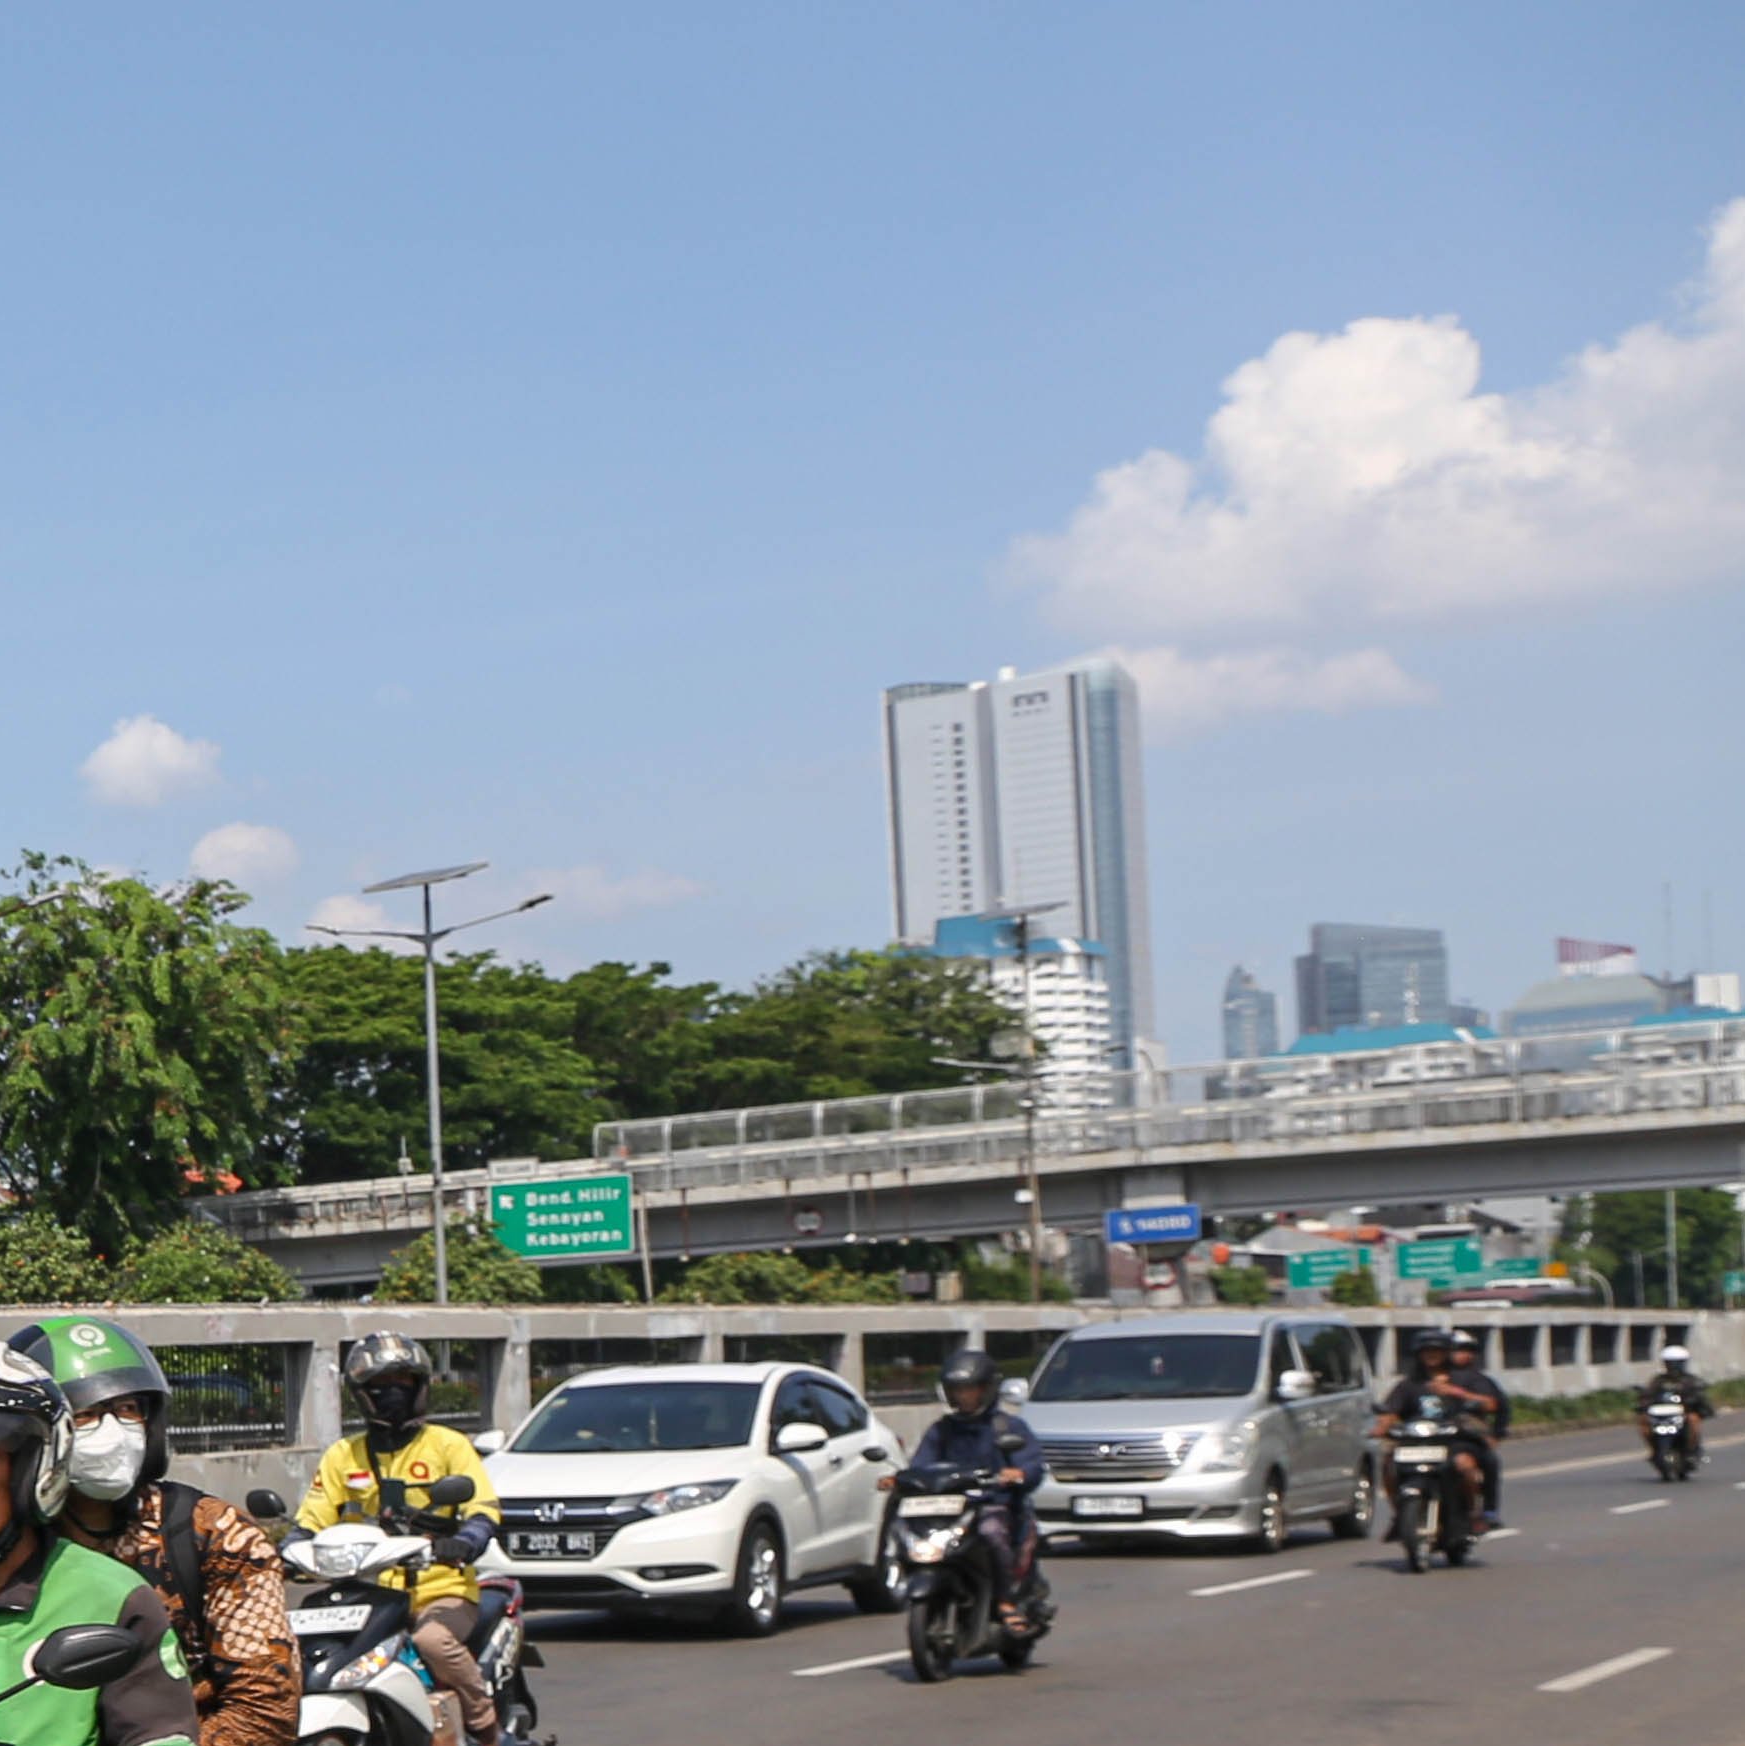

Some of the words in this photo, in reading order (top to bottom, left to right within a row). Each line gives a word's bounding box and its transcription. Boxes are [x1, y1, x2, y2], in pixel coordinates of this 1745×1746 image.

[525, 1191, 573, 1207] Bend.
[577, 1187, 622, 1202] Hilir
[526, 1210, 605, 1226] Senayan
[526, 1230, 623, 1247] Kebayoran
